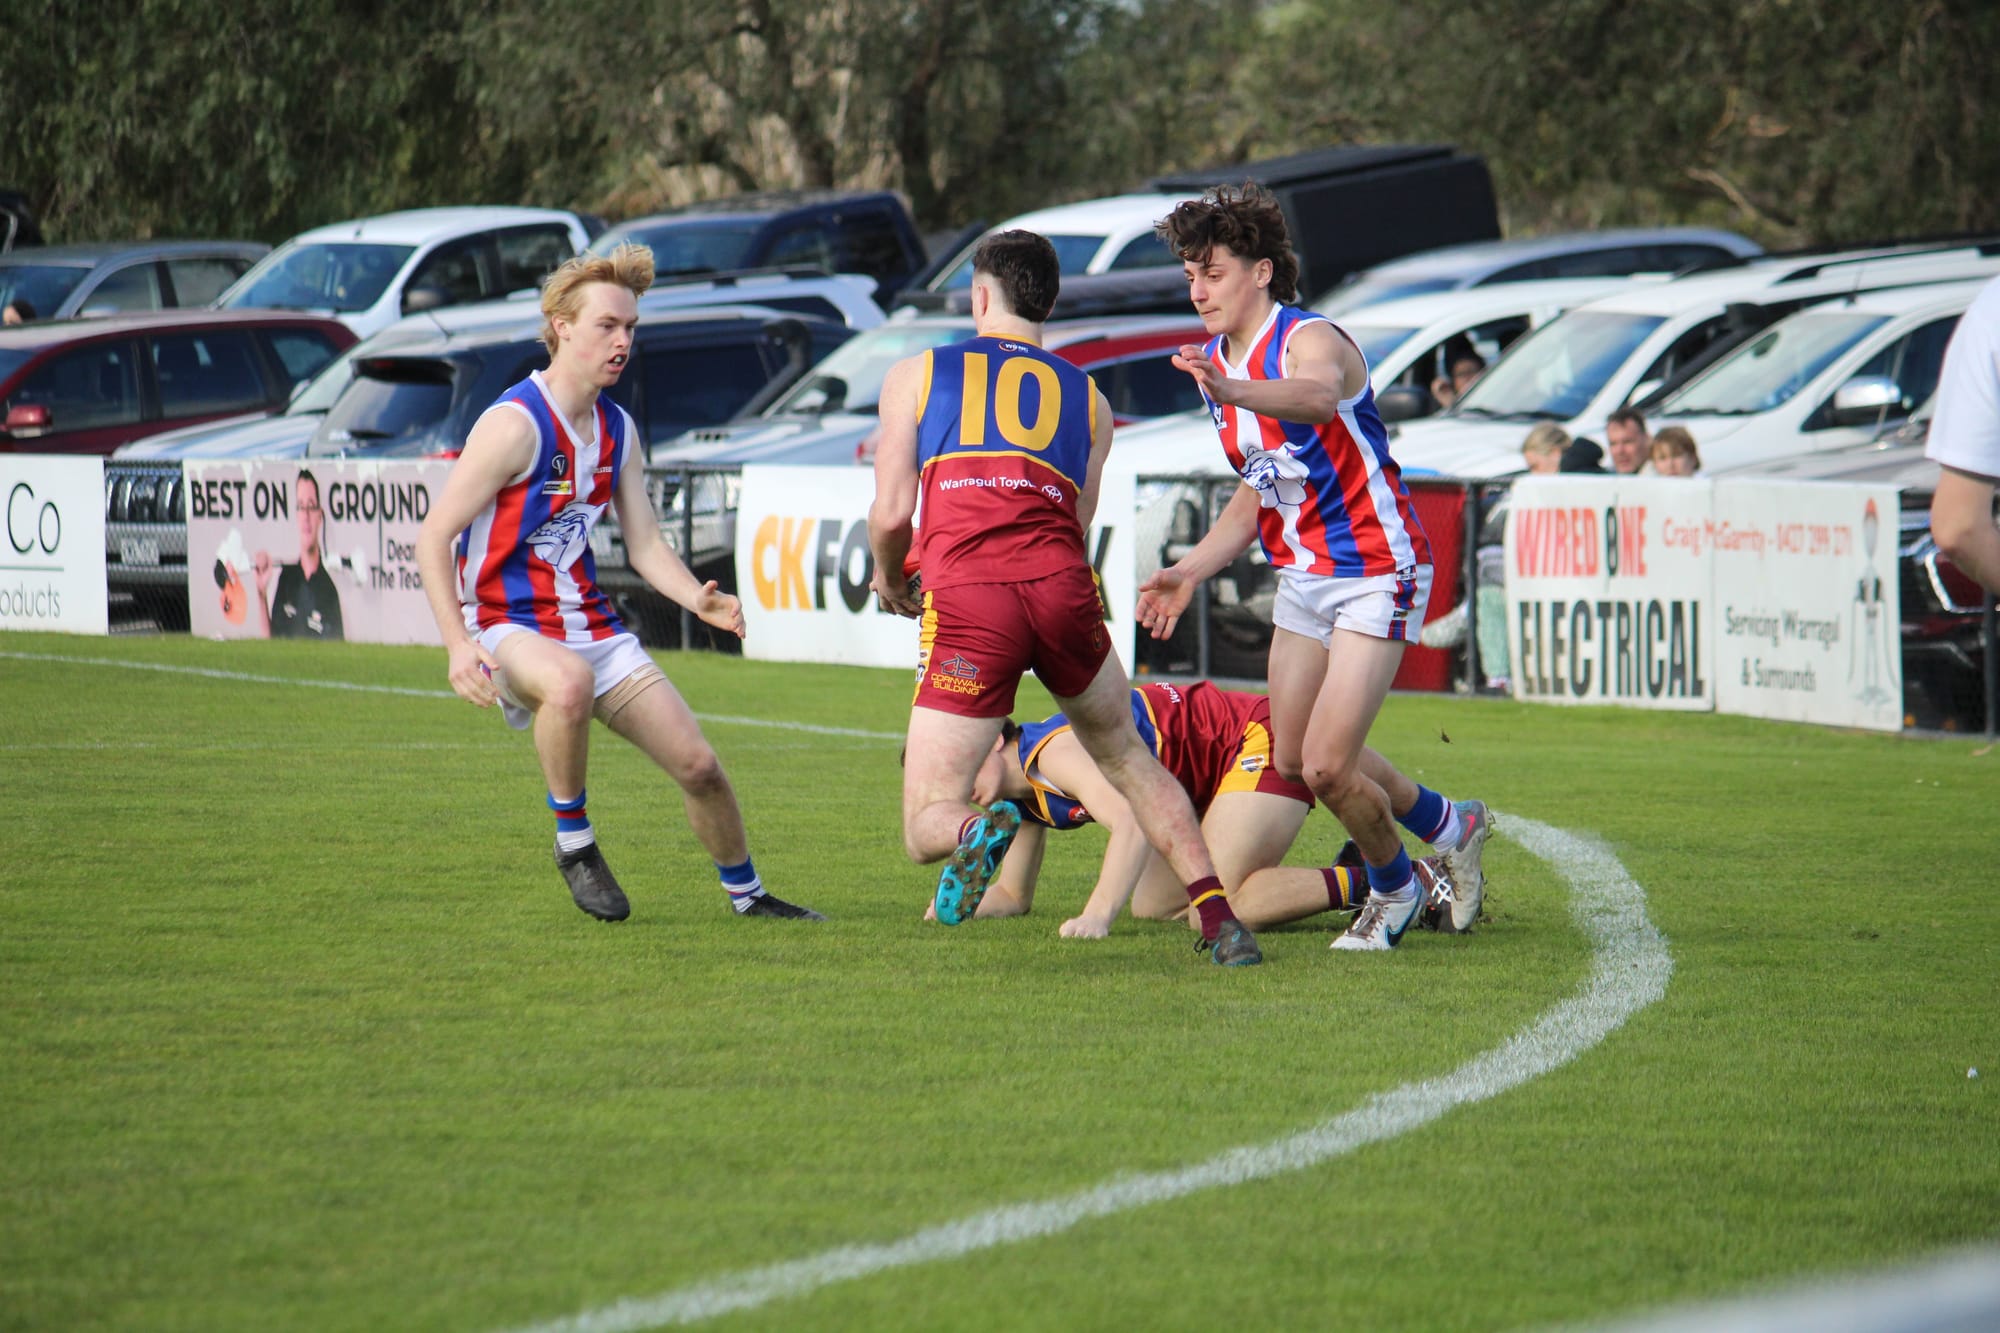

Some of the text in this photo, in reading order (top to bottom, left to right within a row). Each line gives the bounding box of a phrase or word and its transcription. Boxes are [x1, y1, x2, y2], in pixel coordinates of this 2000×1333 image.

[959, 352, 1062, 451] 10
[190, 480, 430, 522] BEST ON GROUND
[939, 477, 1037, 491] Warragul Toyo
[7, 482, 61, 553] Co
[1663, 517, 1700, 557] Craig
[1515, 507, 1599, 577] WIRED
[370, 566, 424, 589] The Tea
[0, 582, 61, 619] oducts
[1519, 599, 1705, 697] ELECTRICAL
[1726, 605, 1840, 651] Servicing Warragul
[931, 673, 986, 689] CORNWALL
[933, 680, 980, 696] BUILDING
[1754, 658, 1817, 691] Surrounds
